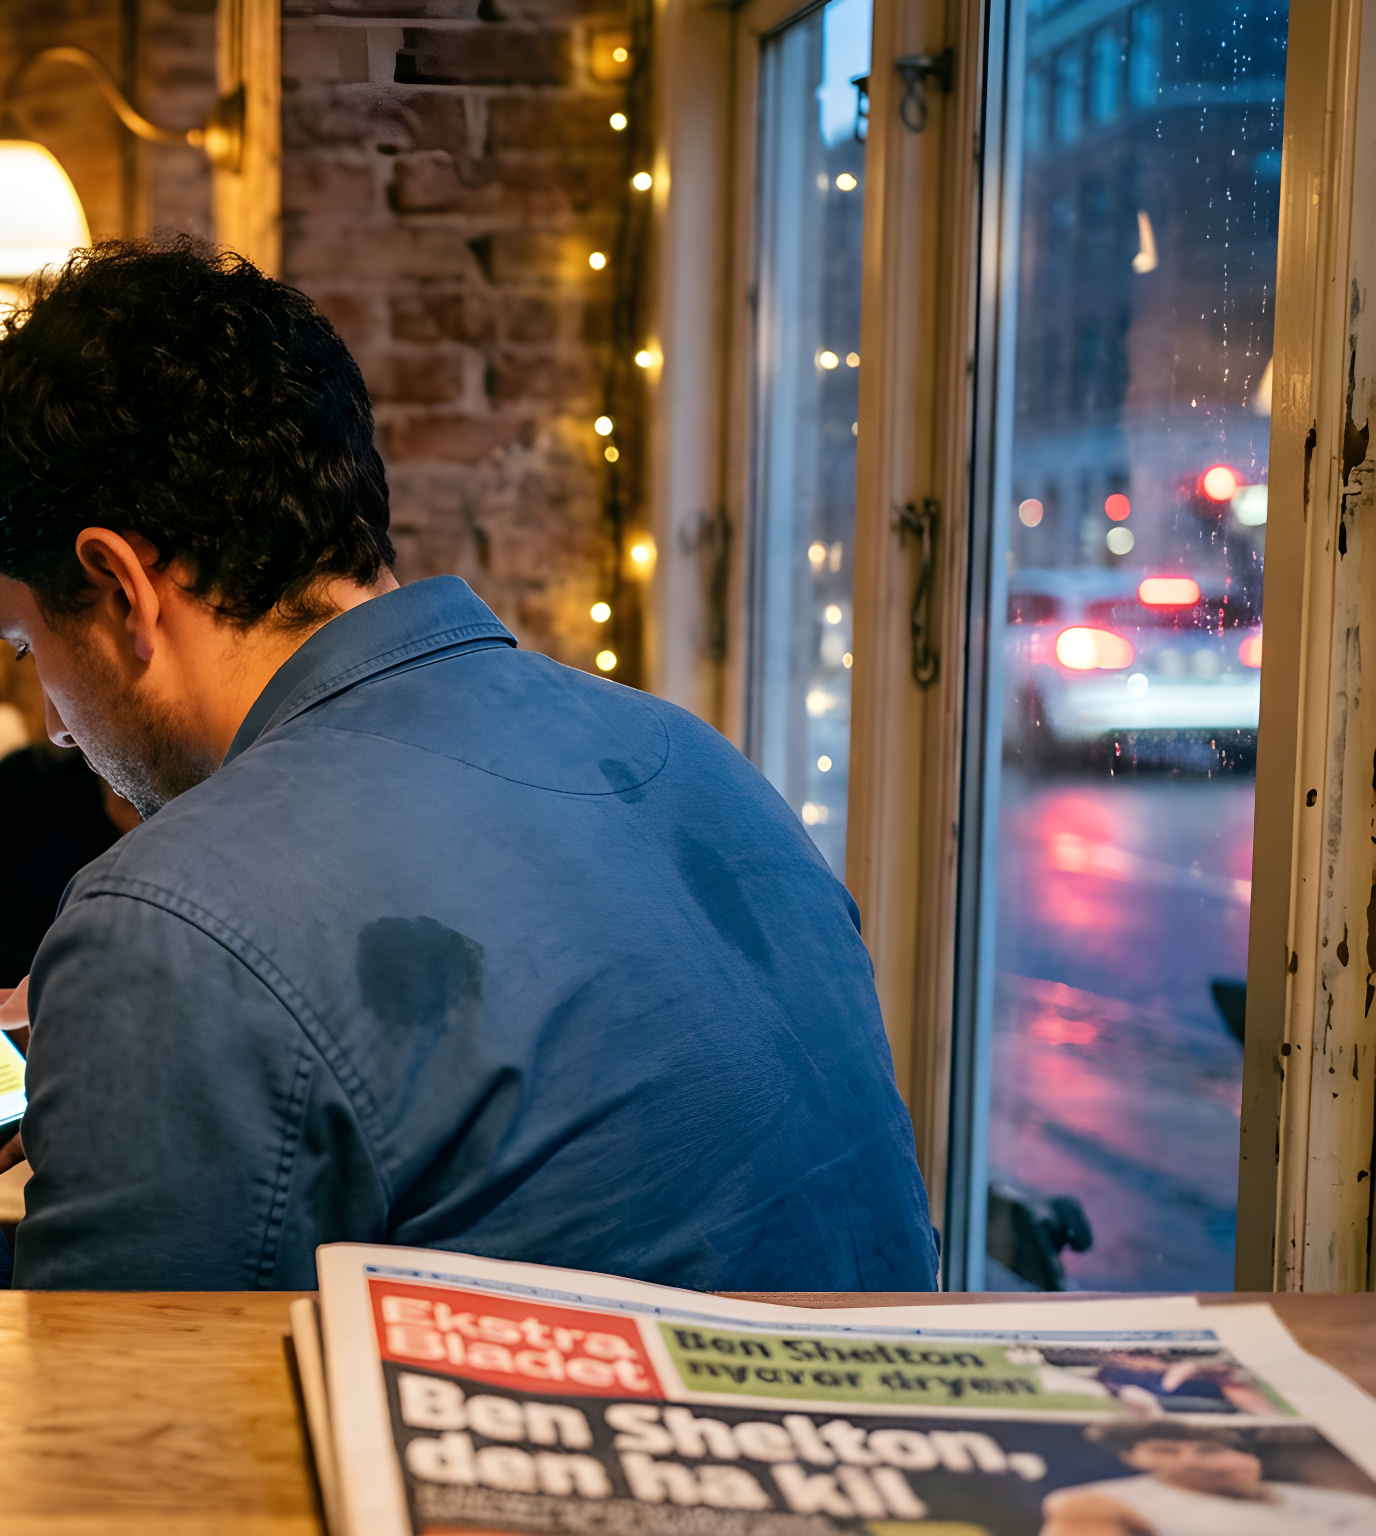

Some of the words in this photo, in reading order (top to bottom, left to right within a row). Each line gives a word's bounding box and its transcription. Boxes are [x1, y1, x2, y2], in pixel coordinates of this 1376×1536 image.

[381, 1295, 637, 1360] Ekstra
[387, 1322, 650, 1393] Bladet
[673, 1329, 771, 1360] Ben
[780, 1337, 987, 1369] Shelton
[397, 1371, 594, 1450] Ben
[604, 1402, 1049, 1483] Shelton,
[404, 1431, 614, 1499] den
[619, 1450, 772, 1511] ha
